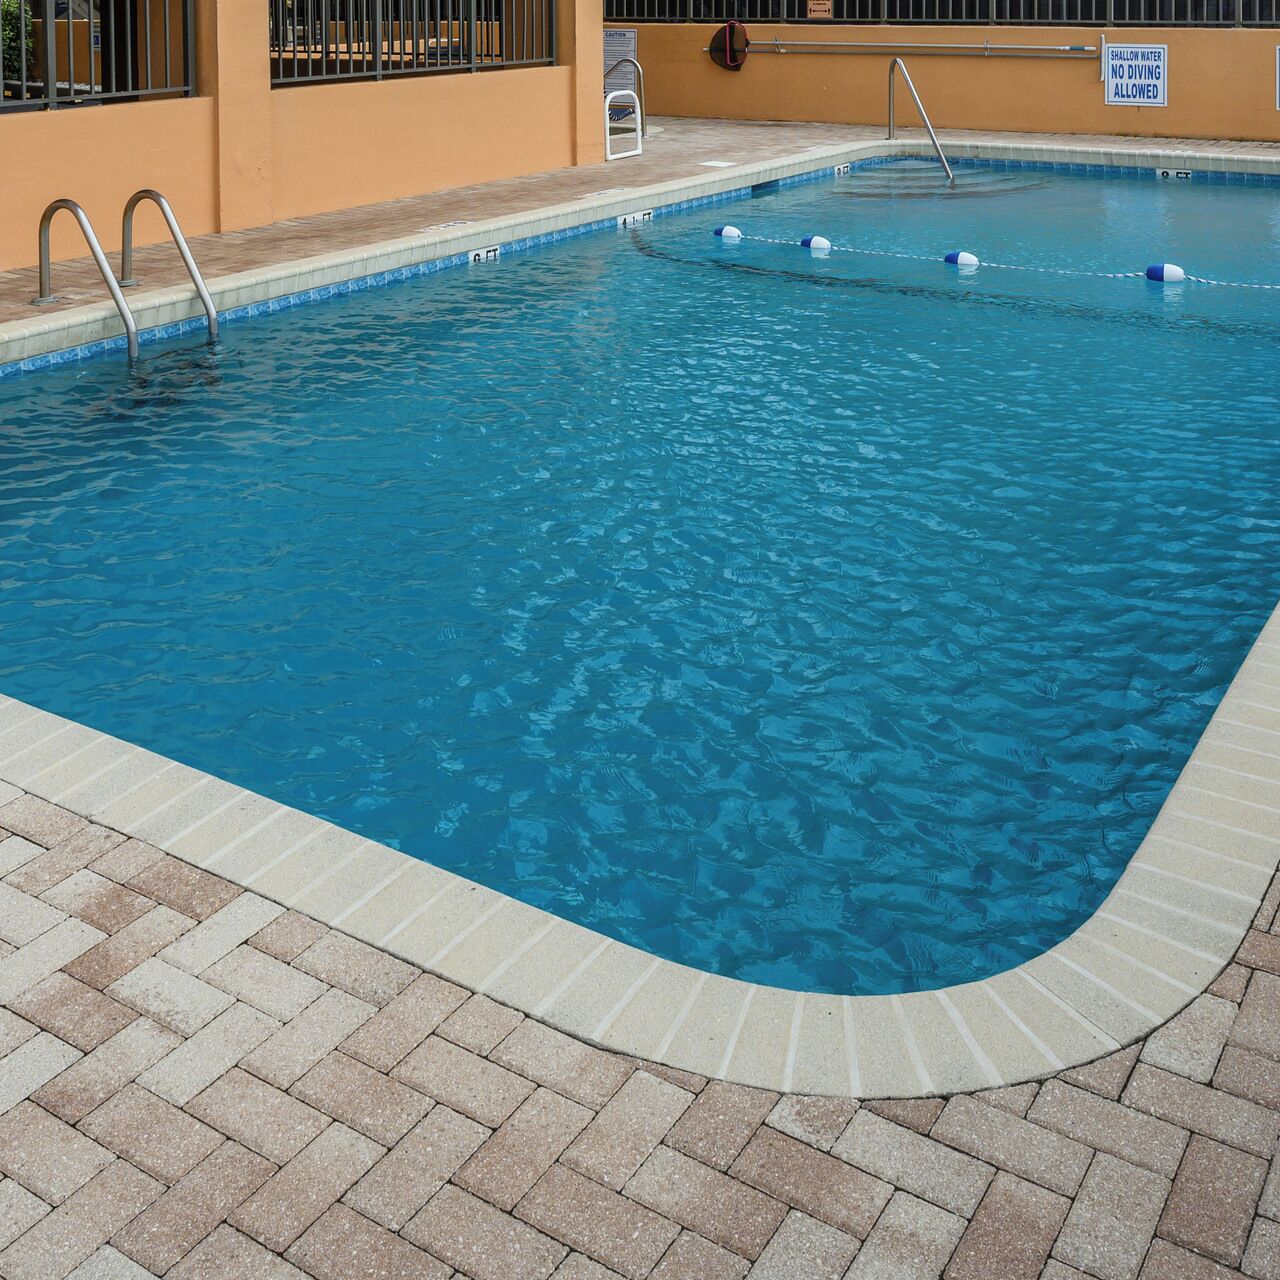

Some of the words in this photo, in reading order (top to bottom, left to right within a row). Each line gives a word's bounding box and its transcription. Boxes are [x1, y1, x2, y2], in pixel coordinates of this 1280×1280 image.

[1111, 50, 1139, 61] SHALLOW
[1141, 51, 1162, 62] WATER
[1111, 64, 1125, 79] NO
[1128, 64, 1161, 80] DIVING
[1114, 82, 1158, 99] ALLOWED
